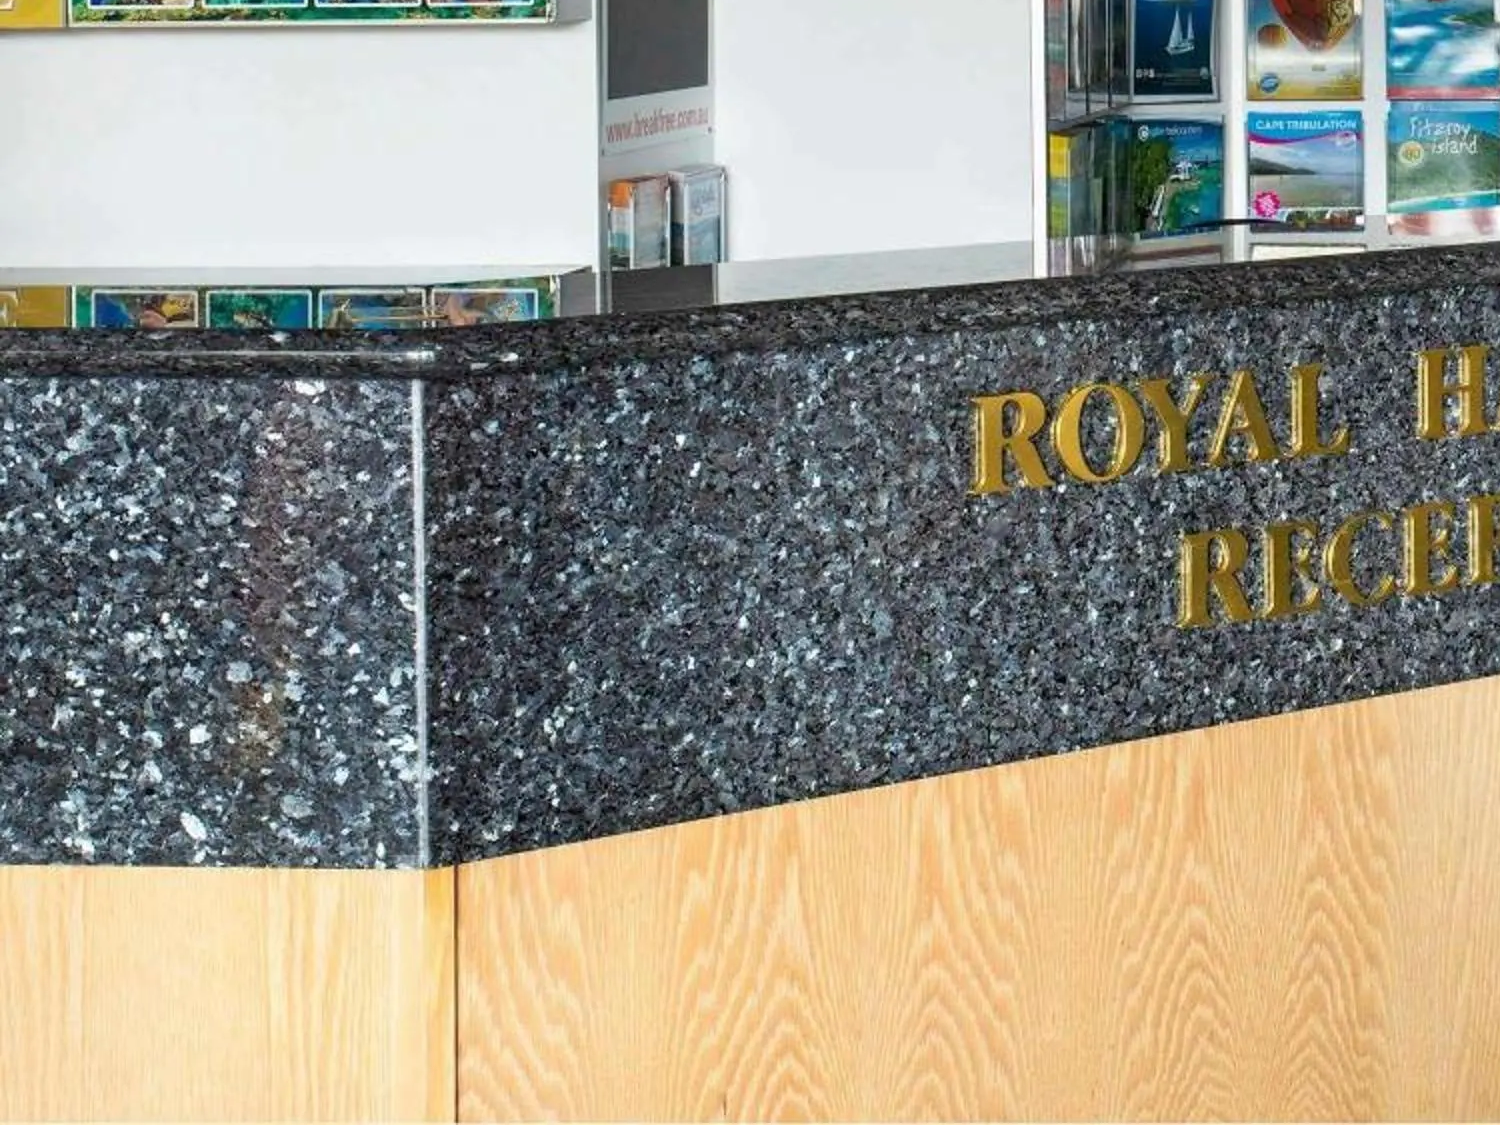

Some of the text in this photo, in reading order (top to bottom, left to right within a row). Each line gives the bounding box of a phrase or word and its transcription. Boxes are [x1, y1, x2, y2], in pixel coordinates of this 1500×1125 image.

[1255, 118, 1358, 131] CAPE TRIBULATION
[969, 361, 1351, 498] ROYAL
